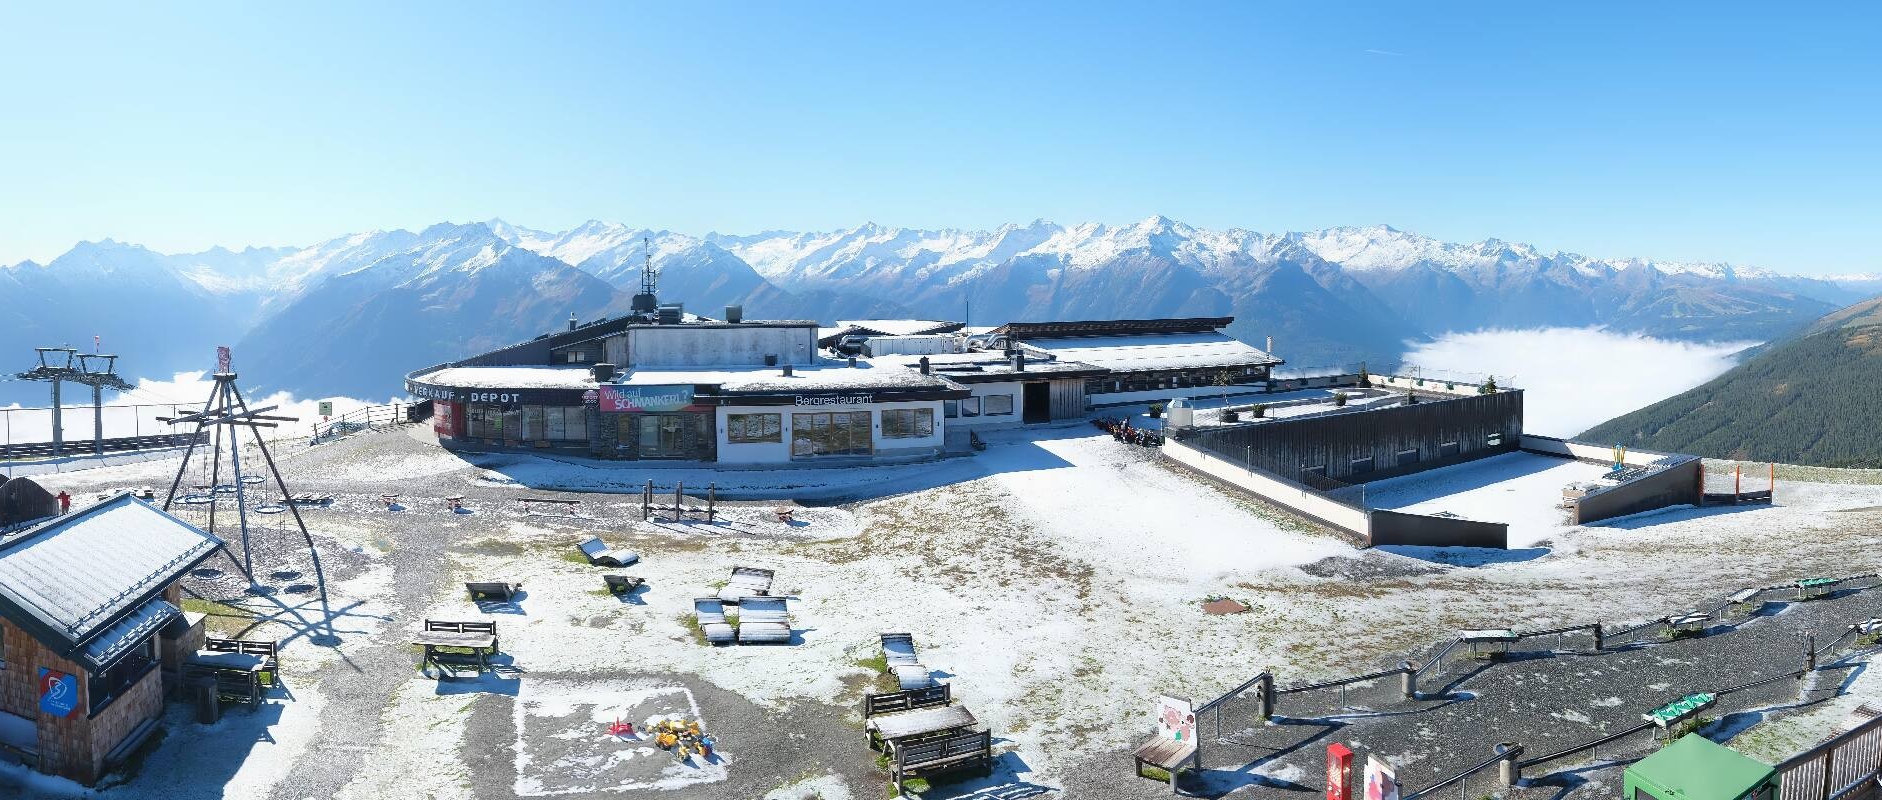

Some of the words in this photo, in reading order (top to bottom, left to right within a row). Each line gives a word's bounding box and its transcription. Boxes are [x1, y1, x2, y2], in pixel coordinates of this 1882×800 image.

[415, 386, 455, 400] VERKAUF
[471, 392, 520, 403] DEPOT
[604, 390, 625, 400] Wild
[627, 388, 642, 398] auf
[795, 394, 873, 406] Bergrestaurant
